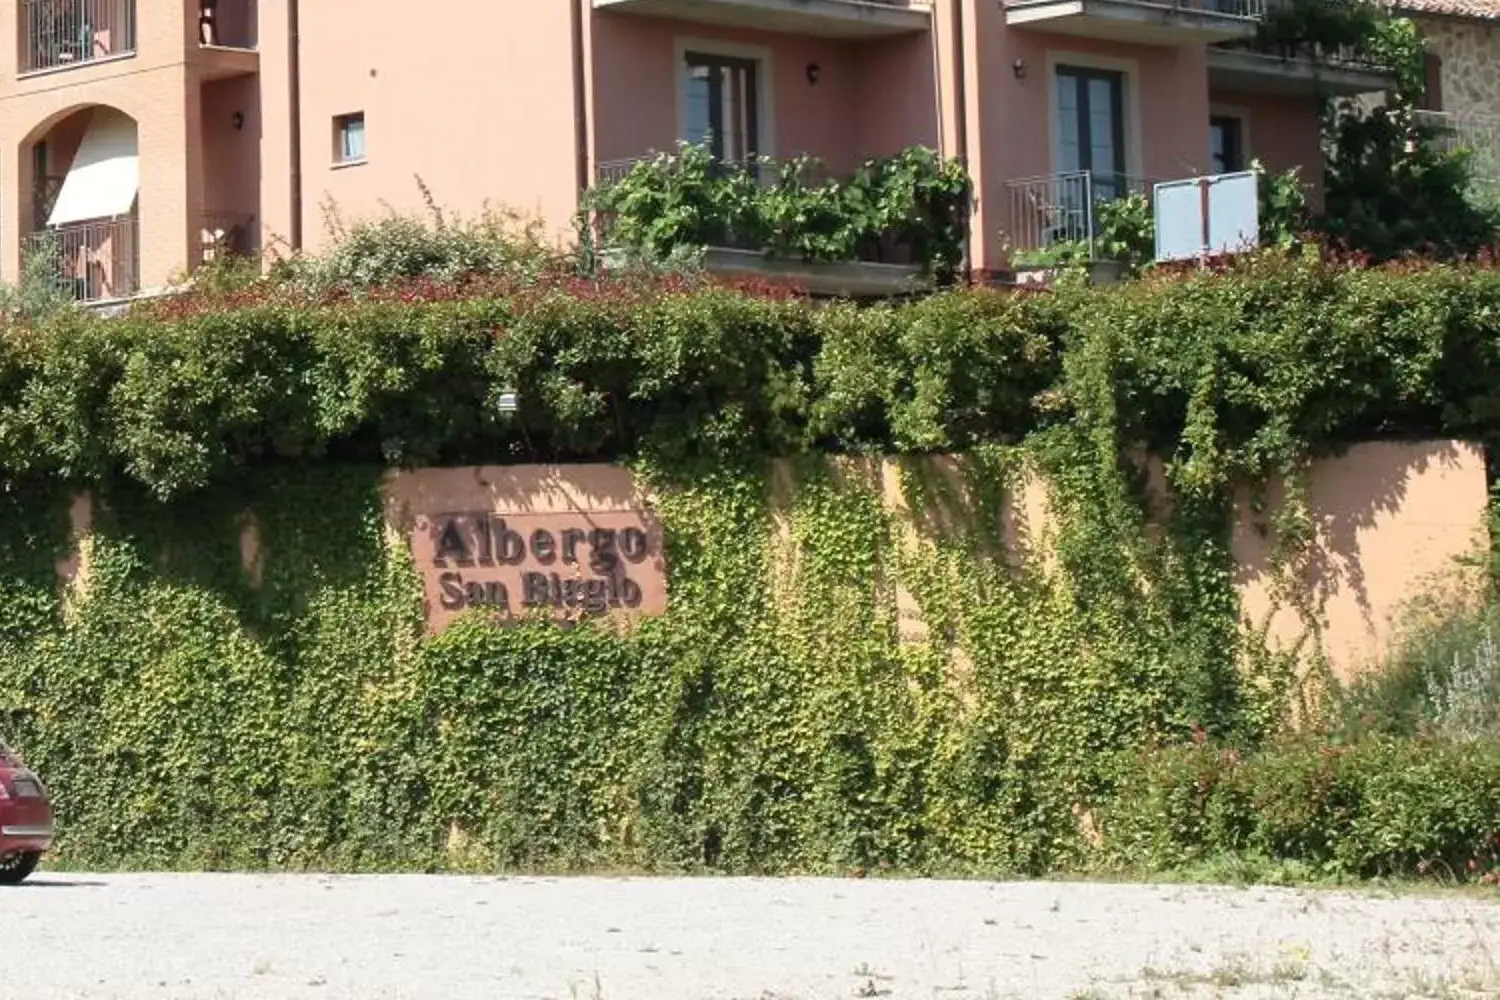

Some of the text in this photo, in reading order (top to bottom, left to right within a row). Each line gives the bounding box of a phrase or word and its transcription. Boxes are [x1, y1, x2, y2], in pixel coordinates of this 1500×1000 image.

[435, 516, 647, 575] Albergo
[440, 573, 642, 612] San Biagio
